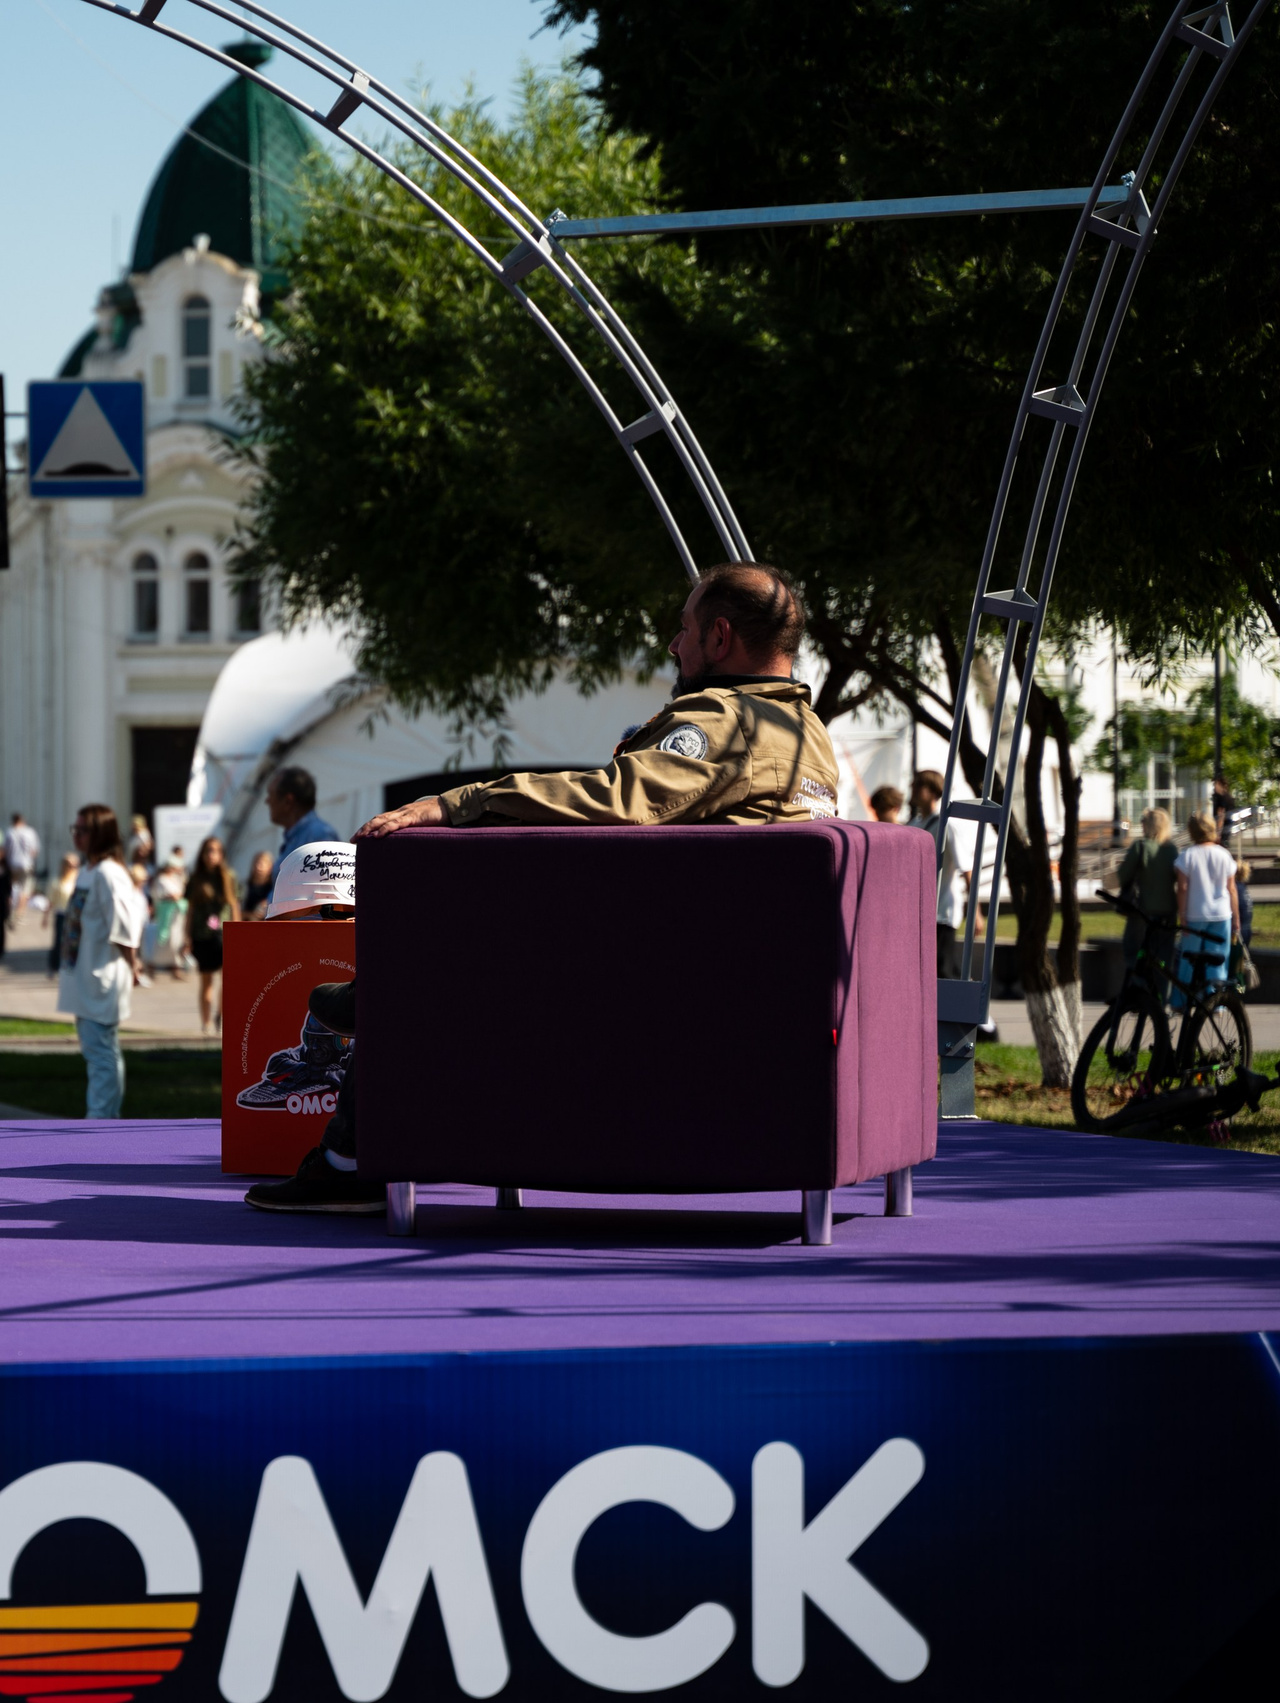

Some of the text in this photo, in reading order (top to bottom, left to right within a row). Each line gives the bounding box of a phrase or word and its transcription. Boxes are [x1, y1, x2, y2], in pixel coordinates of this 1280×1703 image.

[320, 958, 356, 974] МОЛОДЁЖН
[241, 1021, 252, 1075] МОЛОДЁЖНАЯ
[248, 992, 265, 1023] СТОЛИЦА
[287, 1090, 339, 1115] ОМС
